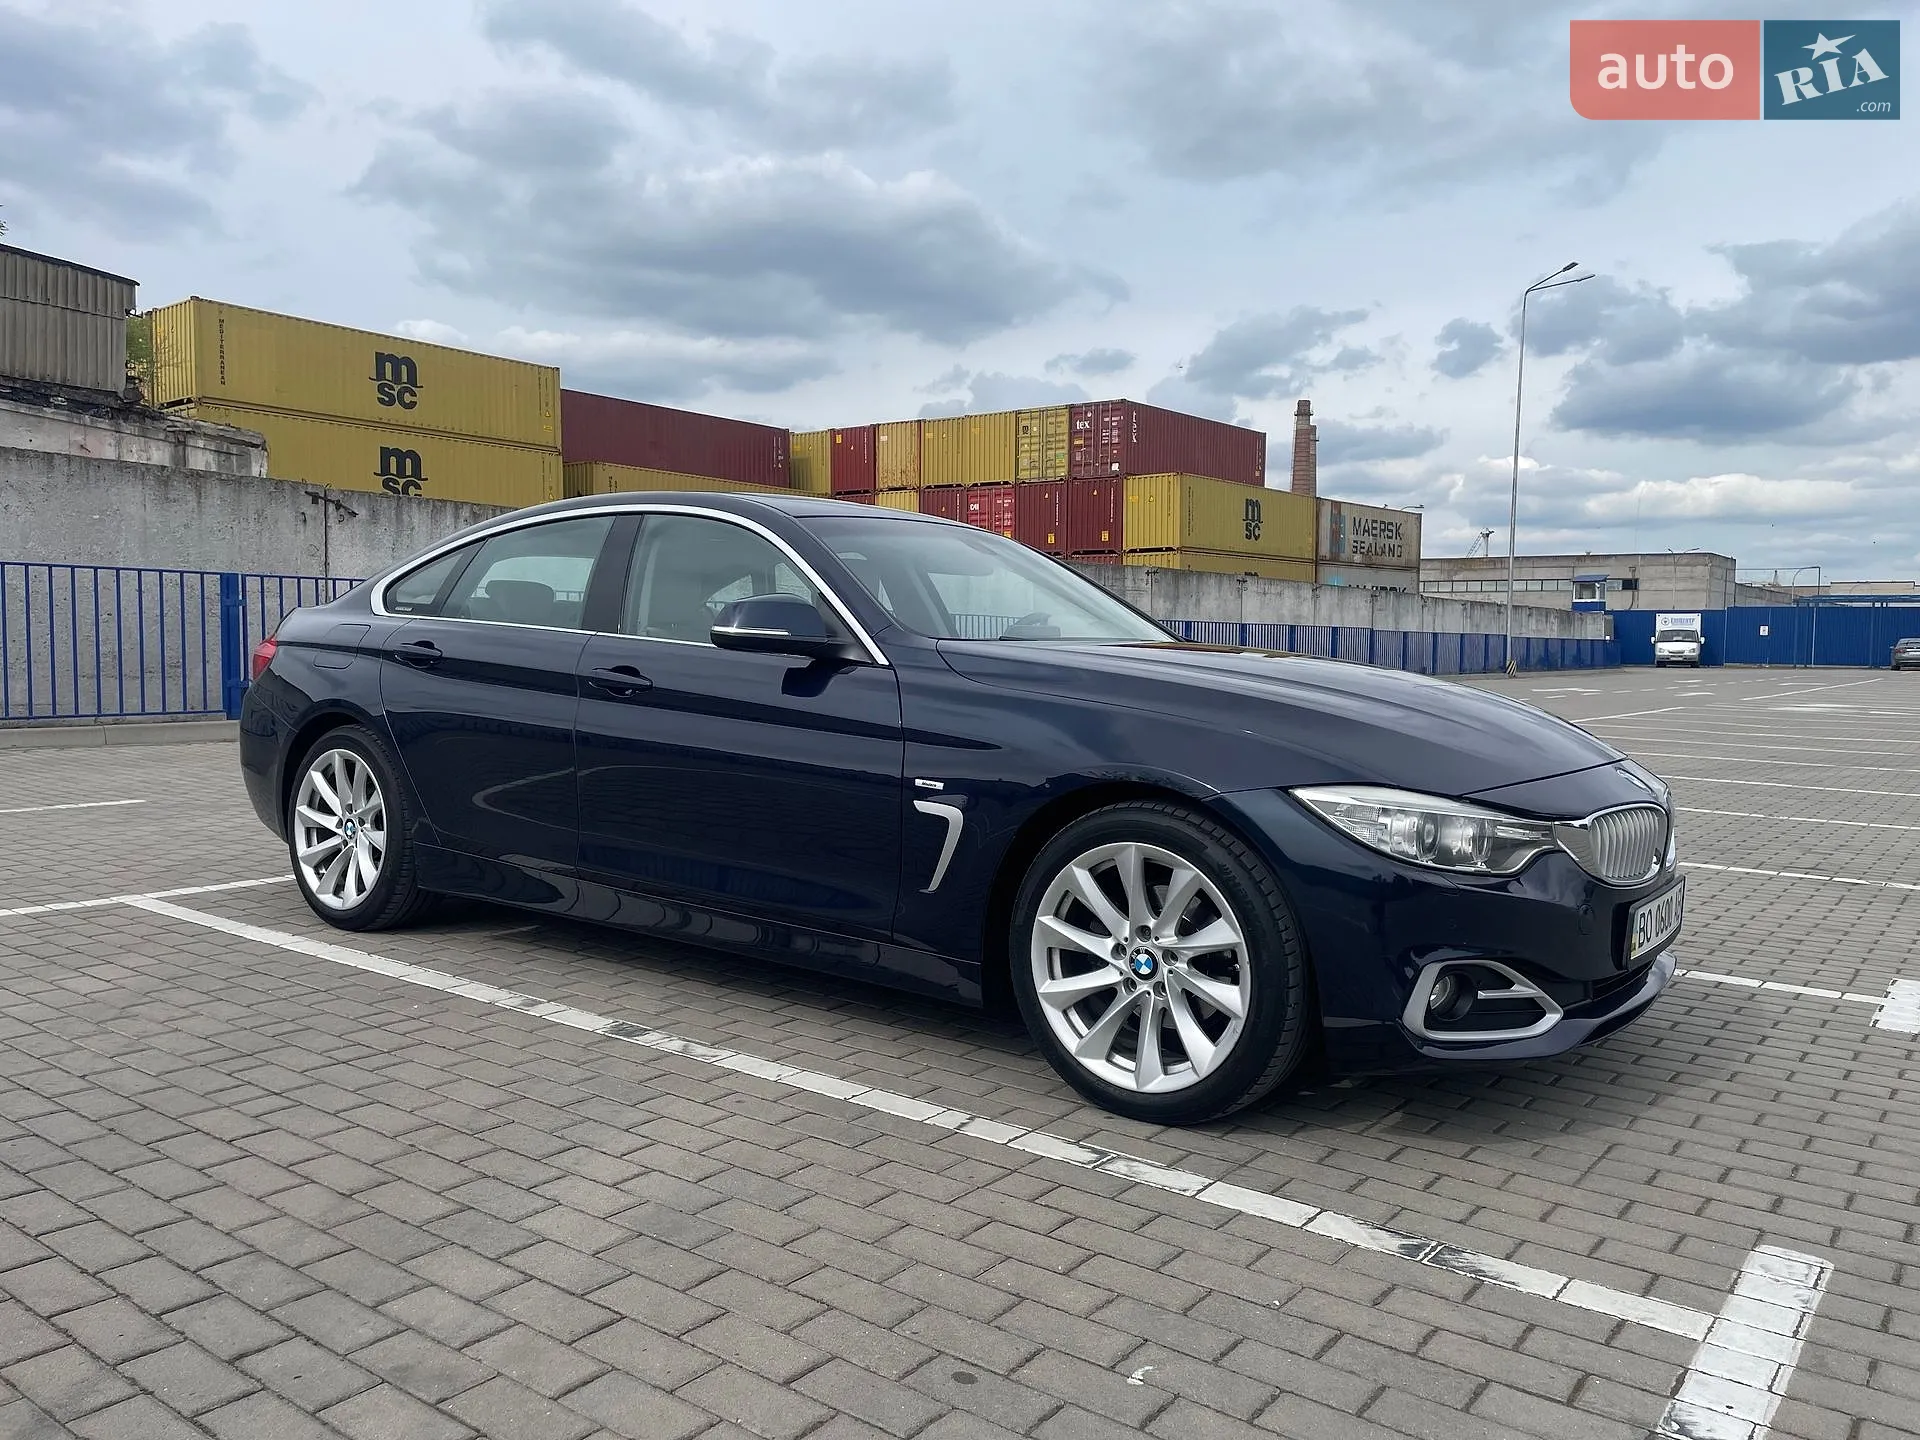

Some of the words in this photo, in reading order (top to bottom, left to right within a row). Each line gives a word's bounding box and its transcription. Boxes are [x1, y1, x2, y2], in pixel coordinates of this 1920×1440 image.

[1352, 516, 1402, 540] MAERSK
[1352, 540, 1402, 558] SEALAND
[1638, 908, 1652, 948] BO
